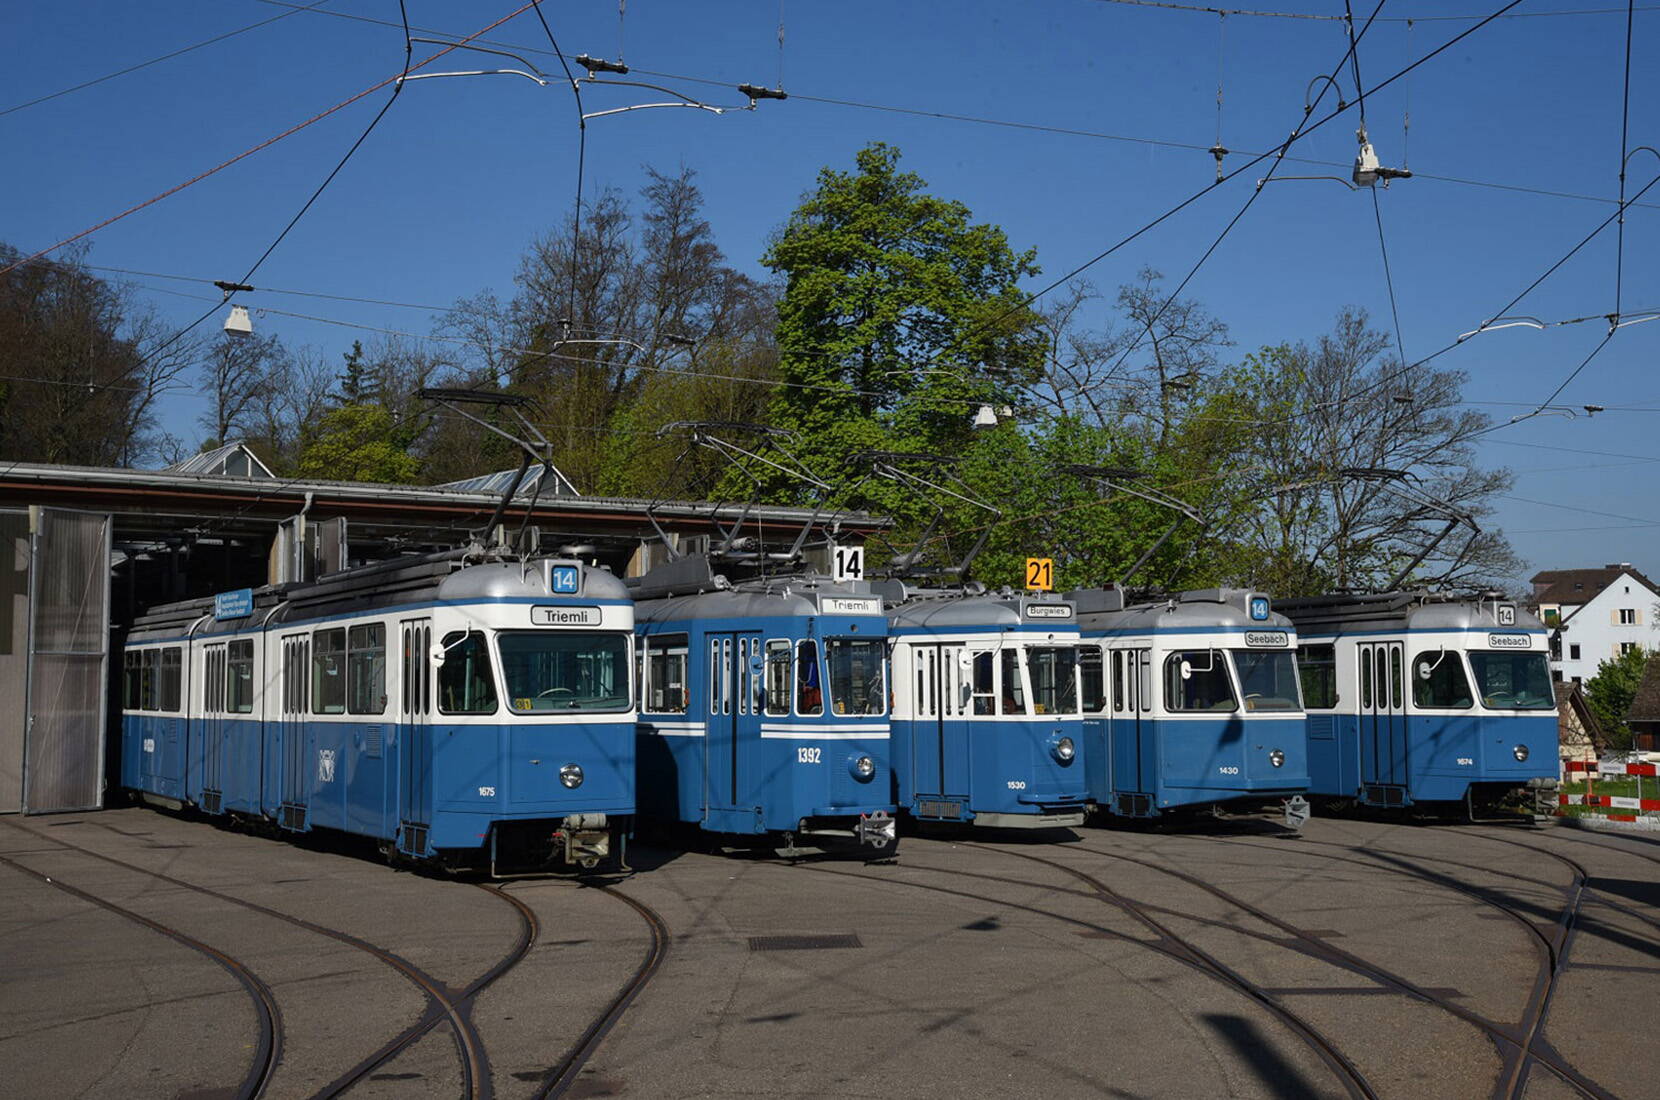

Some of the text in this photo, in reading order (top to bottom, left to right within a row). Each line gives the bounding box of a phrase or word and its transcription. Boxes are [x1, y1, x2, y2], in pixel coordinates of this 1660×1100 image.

[836, 550, 861, 578] 14
[553, 570, 575, 589] 14
[1029, 562, 1050, 587] 21
[832, 600, 870, 611] Triemli
[1252, 602, 1266, 617] 14
[545, 610, 588, 623] Triemli
[1499, 610, 1513, 622] 14
[1247, 633, 1286, 645] Seebach
[1491, 635, 1528, 647] Seebach
[798, 748, 820, 763] 1392
[1219, 767, 1239, 775] 1430
[1007, 781, 1026, 790] 1530
